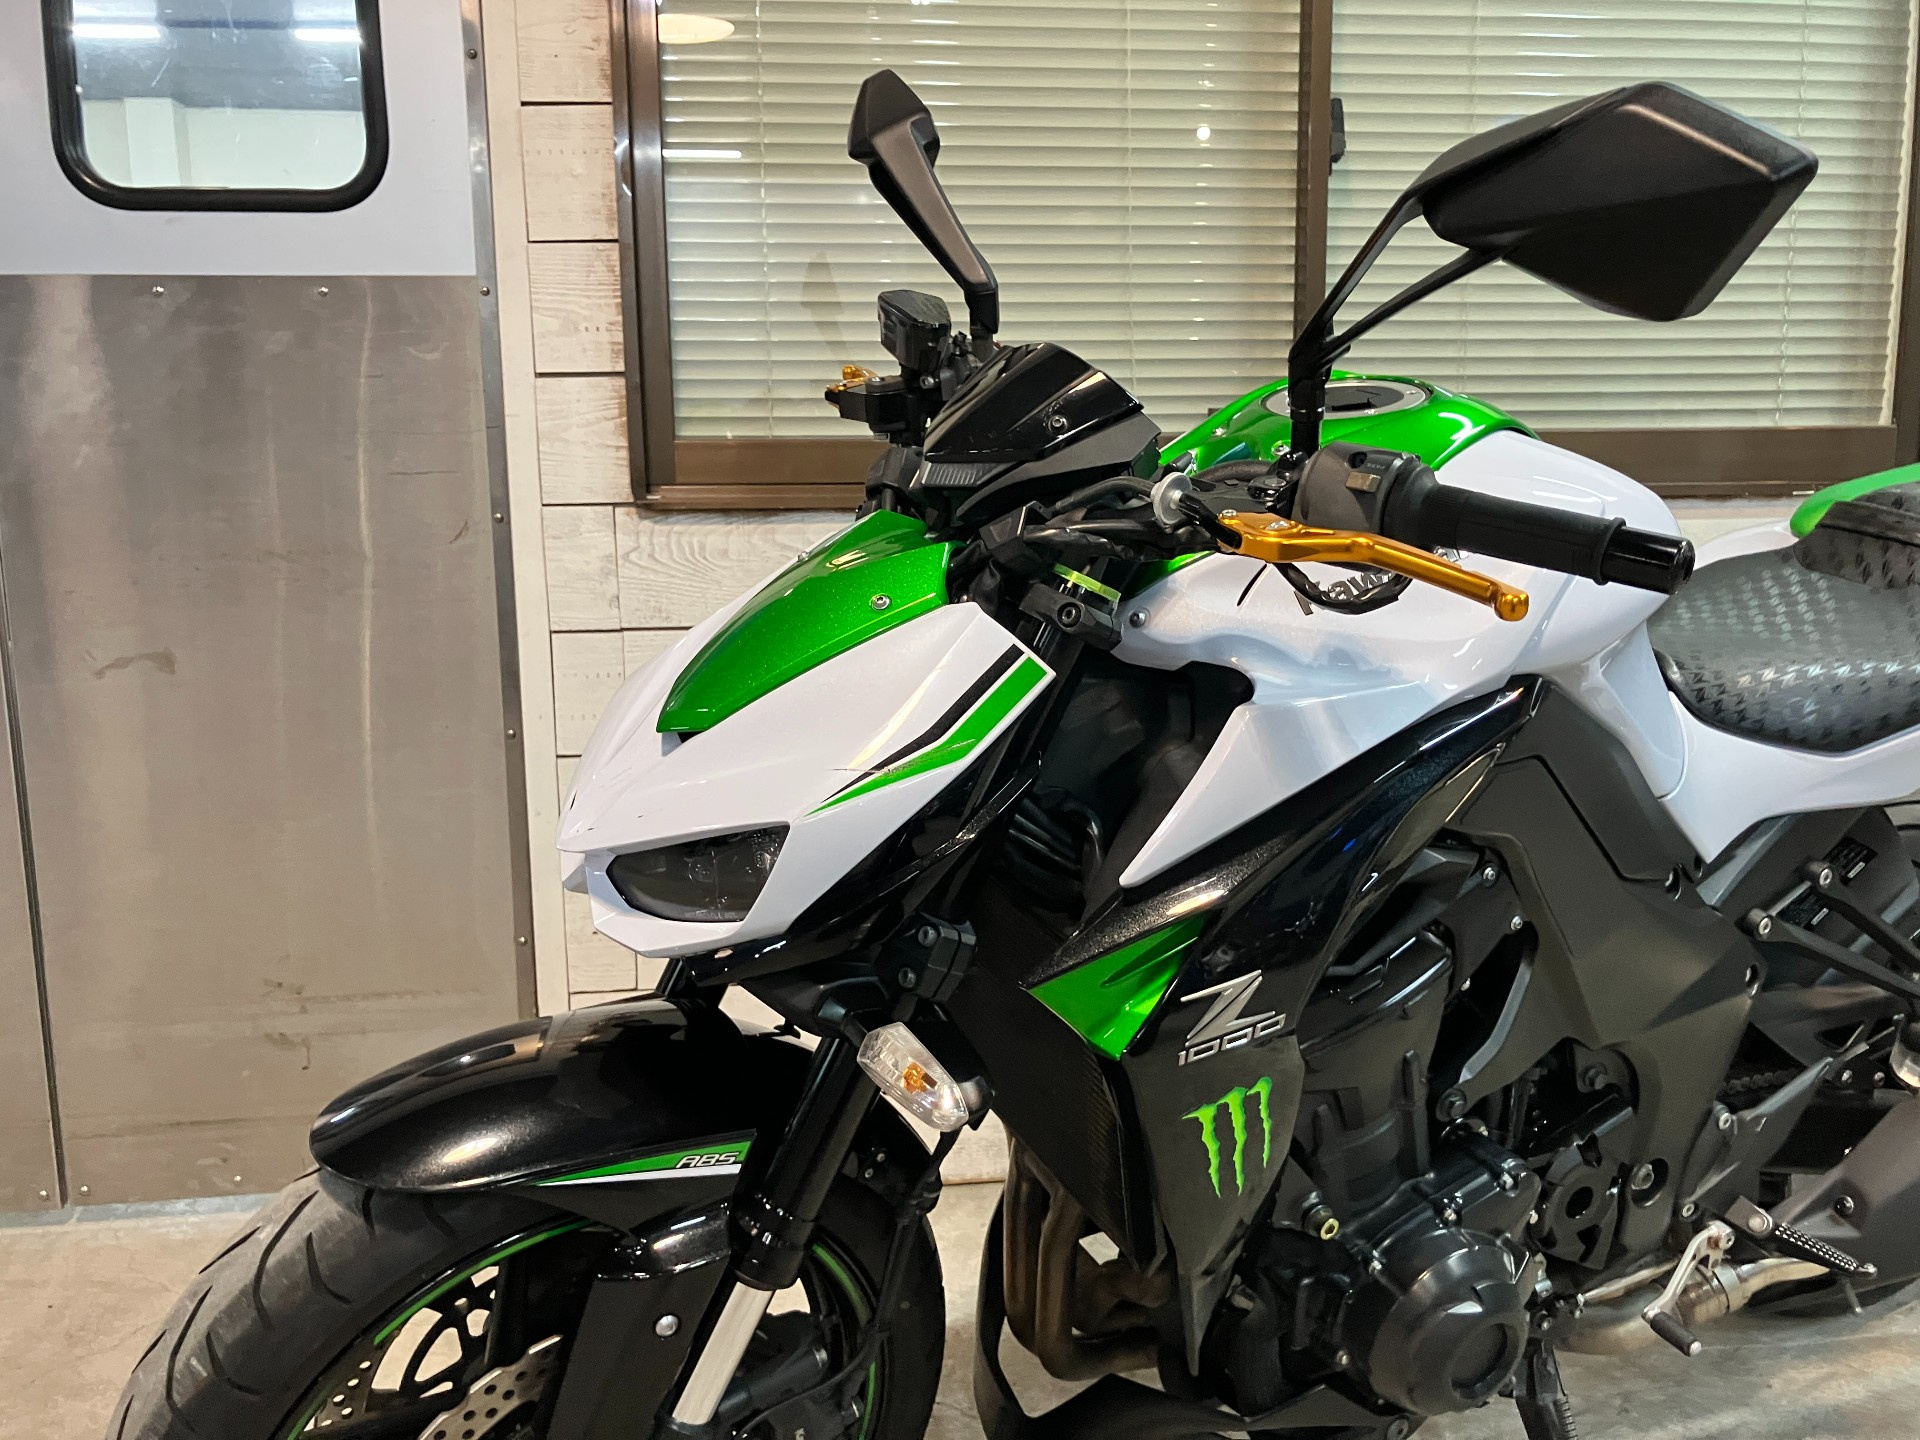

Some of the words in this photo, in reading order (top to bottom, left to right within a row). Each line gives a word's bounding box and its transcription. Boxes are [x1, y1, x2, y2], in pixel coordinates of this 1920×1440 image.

[1180, 969, 1276, 1048] Z
[1178, 1012, 1287, 1067] 1000
[675, 1151, 740, 1169] ABS
